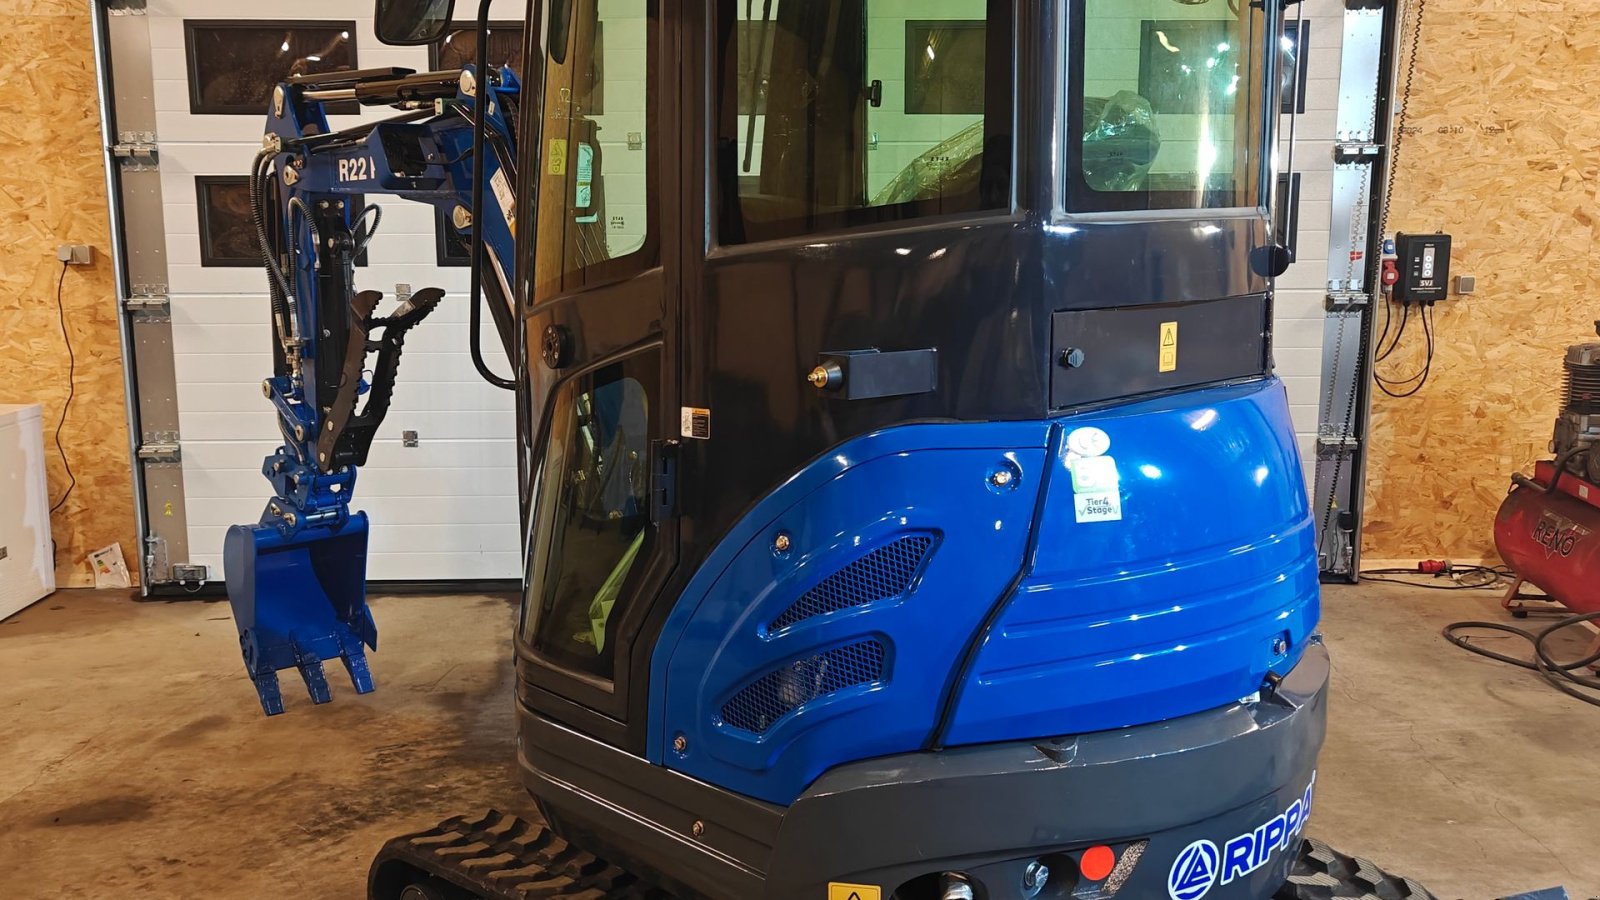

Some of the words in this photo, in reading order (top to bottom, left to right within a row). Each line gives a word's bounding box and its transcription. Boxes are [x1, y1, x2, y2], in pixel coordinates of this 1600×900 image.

[1087, 506, 1112, 516] Stage
[1531, 519, 1576, 558] RENO
[1220, 782, 1312, 886] RIPPA
